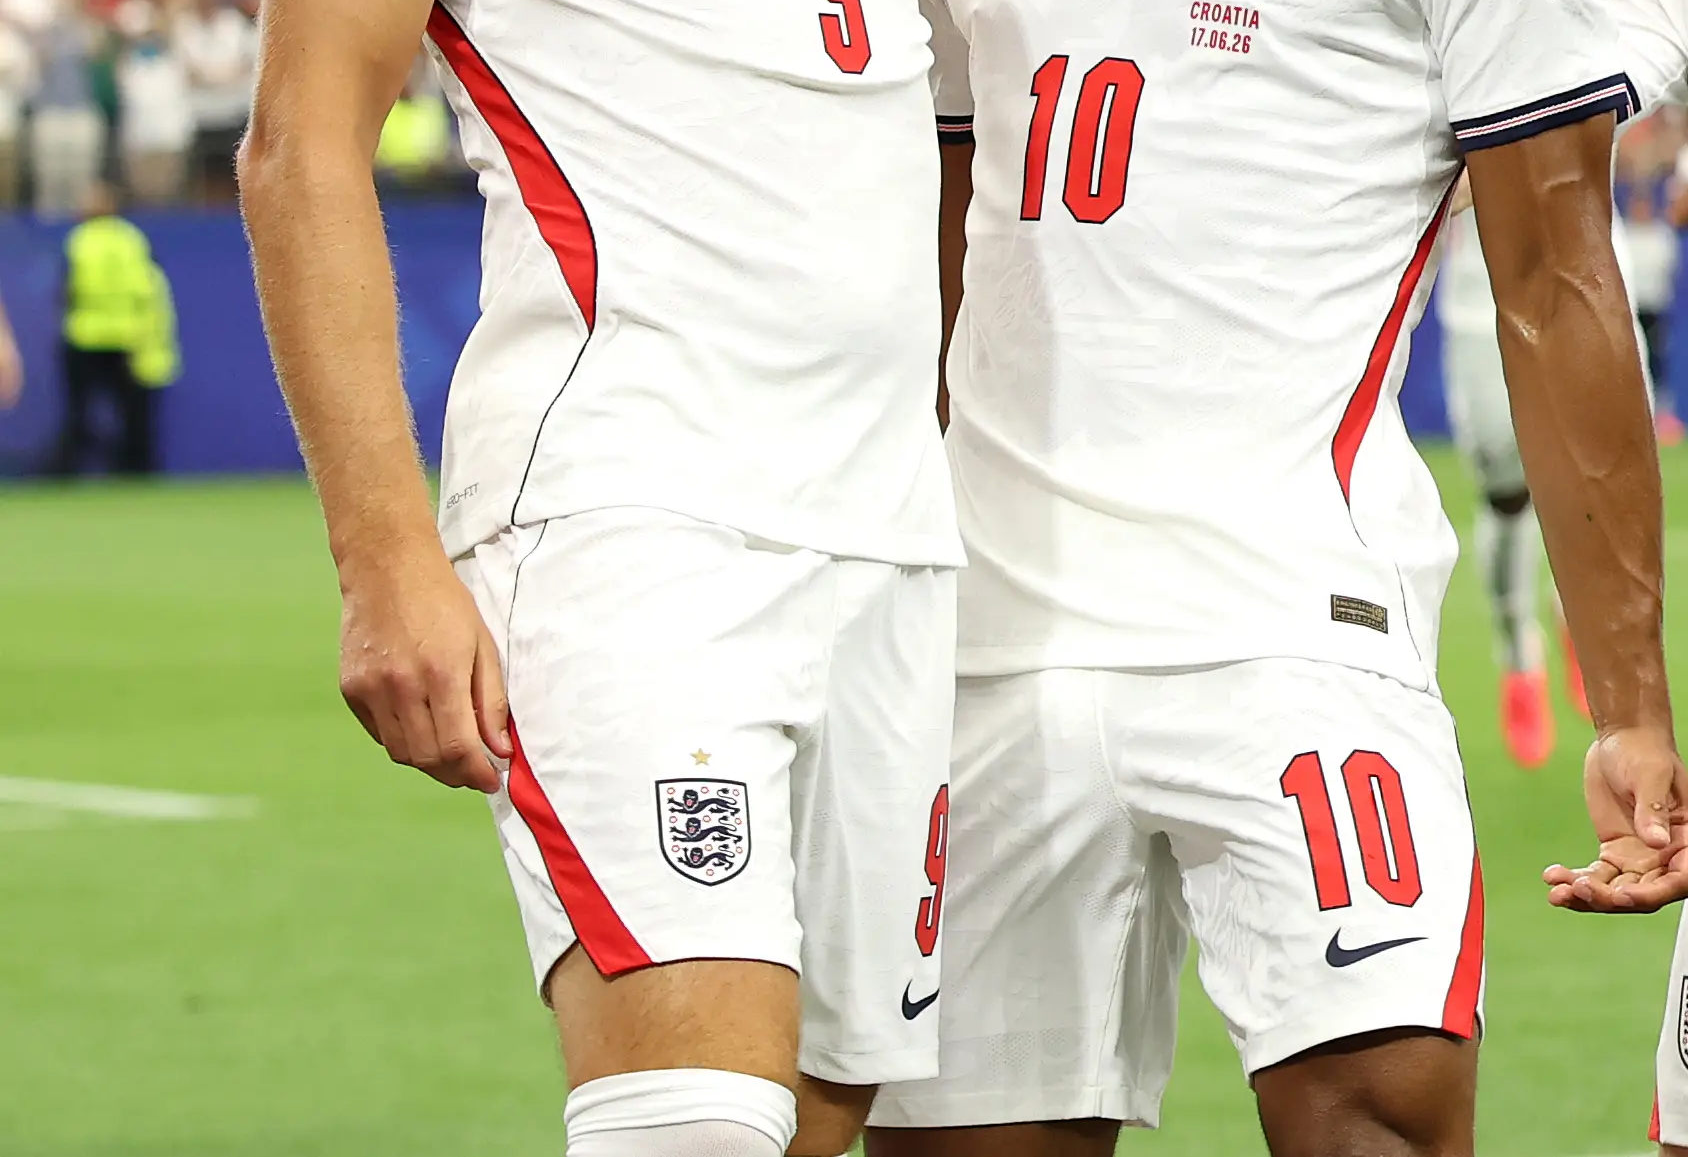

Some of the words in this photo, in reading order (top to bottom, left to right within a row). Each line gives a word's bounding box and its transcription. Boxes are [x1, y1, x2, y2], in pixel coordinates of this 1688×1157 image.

[1190, 1, 1259, 30] CROATIA
[1190, 27, 1252, 54] 17.06.26
[1020, 54, 1145, 225] 10
[1279, 749, 1424, 911] 10
